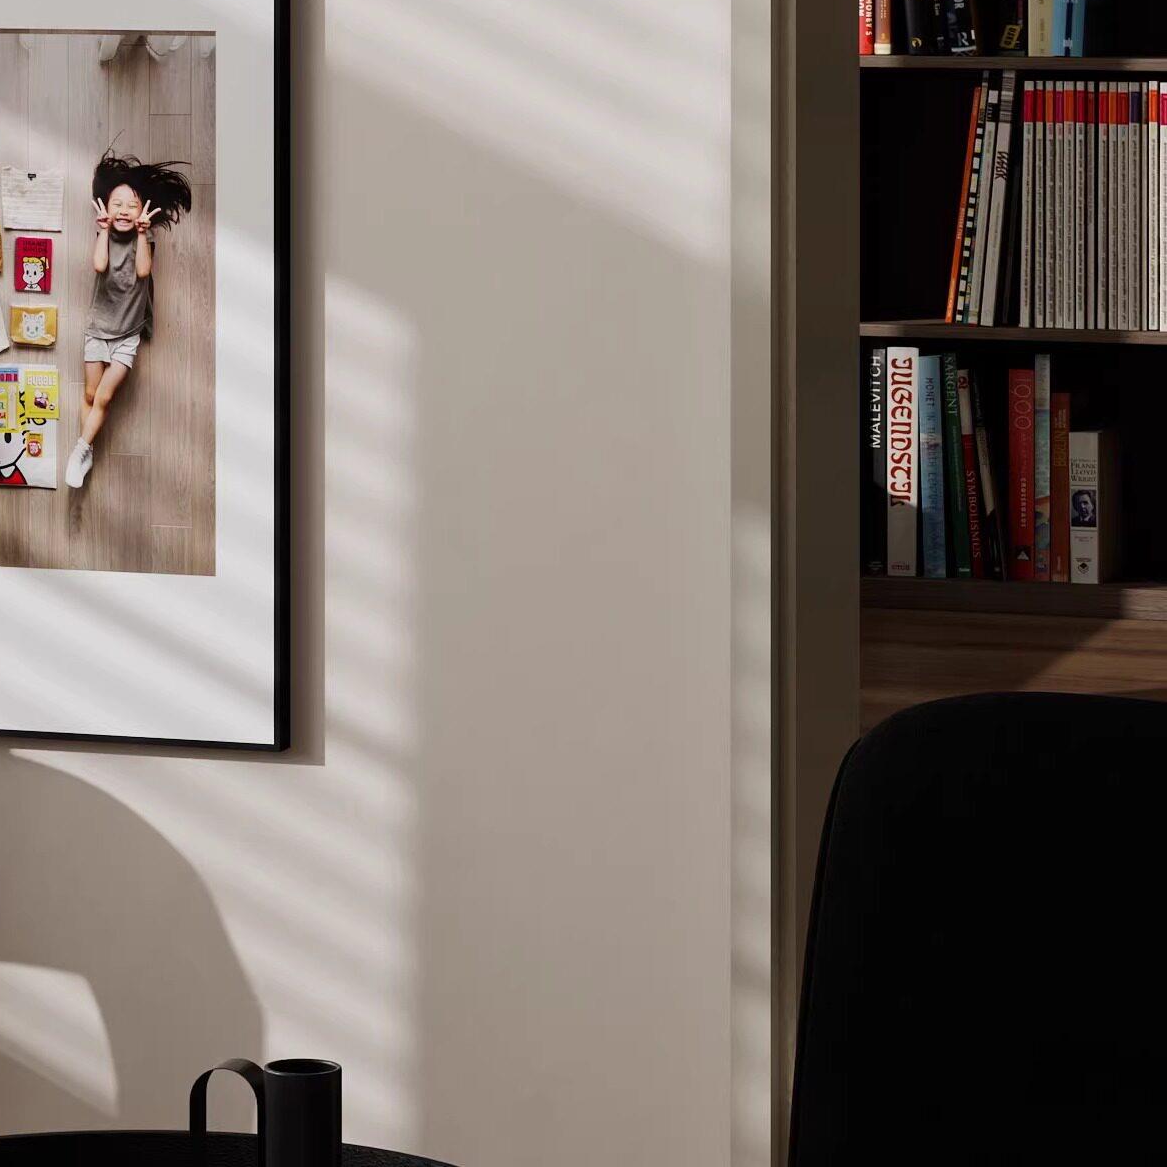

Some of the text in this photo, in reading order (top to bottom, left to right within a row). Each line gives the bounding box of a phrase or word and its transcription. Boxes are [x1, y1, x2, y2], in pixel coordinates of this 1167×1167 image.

[869, 355, 882, 449] MALEVITCH
[925, 377, 935, 407] MONET
[944, 355, 958, 417] SARGENT
[890, 357, 913, 507] JUGENDSTIL
[965, 470, 982, 559] SYMBOLISMUS
